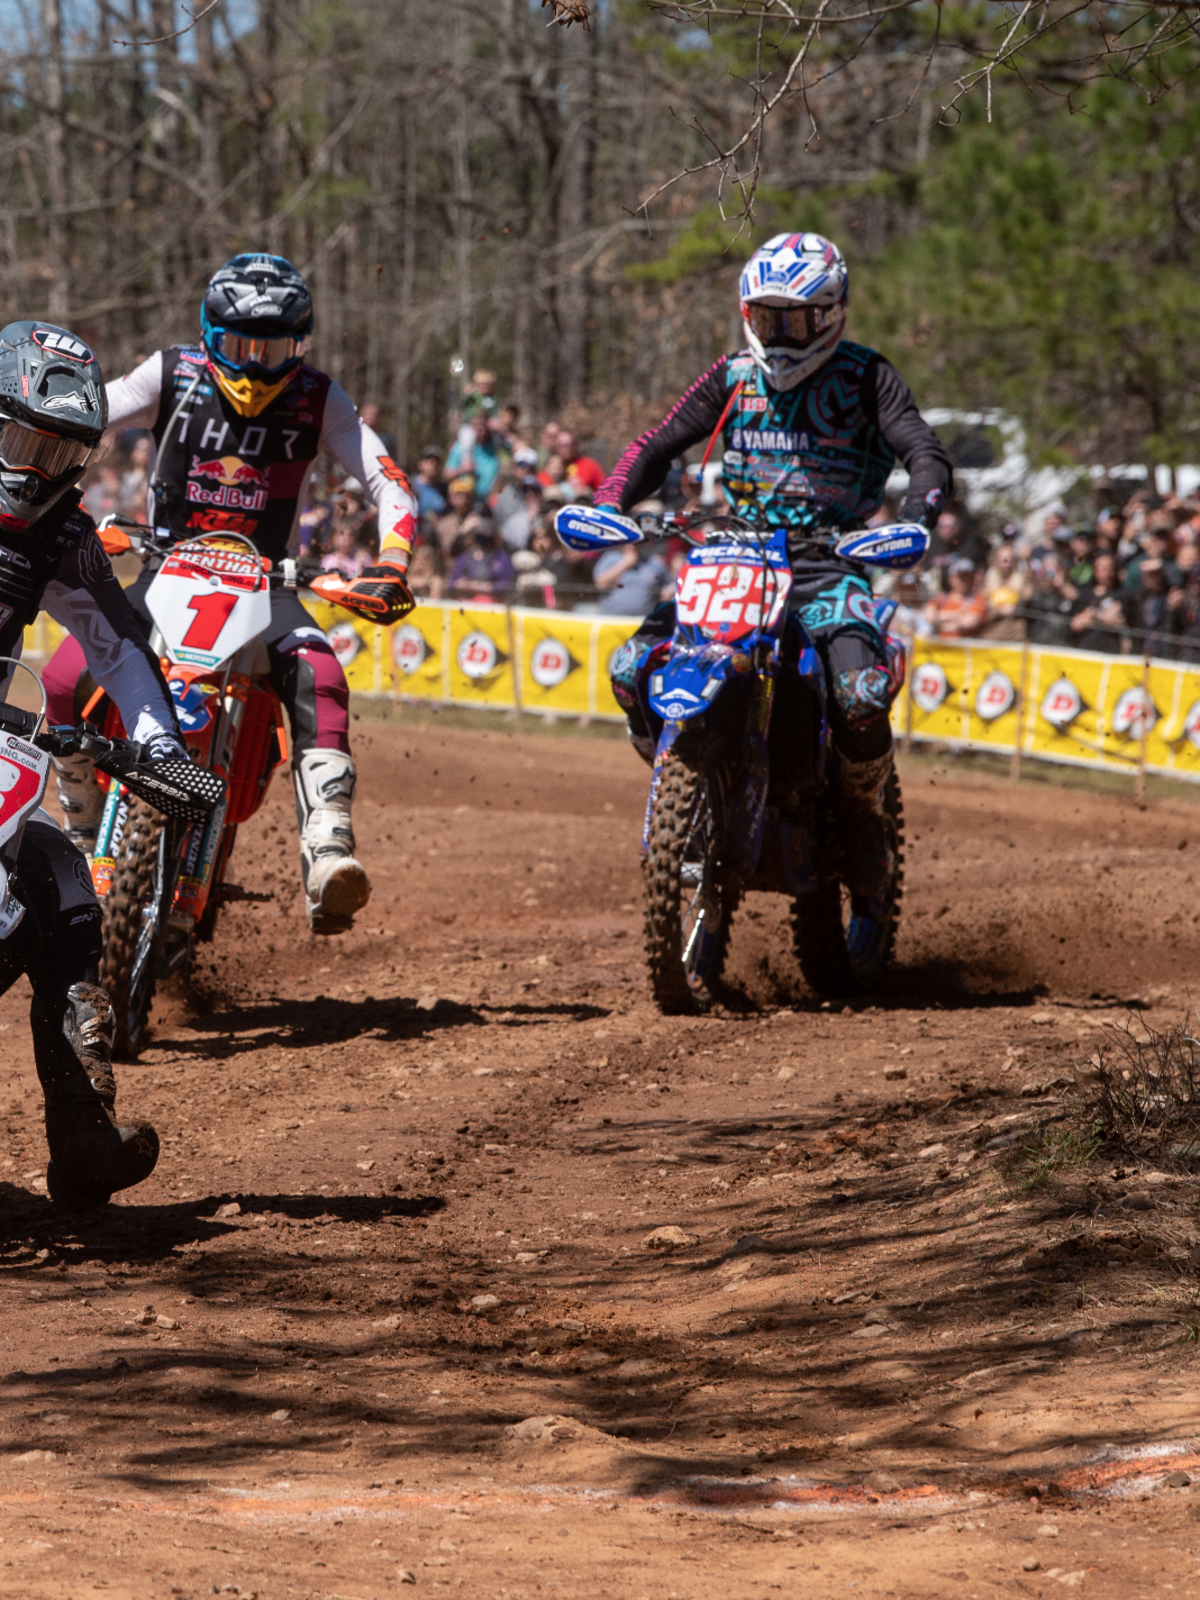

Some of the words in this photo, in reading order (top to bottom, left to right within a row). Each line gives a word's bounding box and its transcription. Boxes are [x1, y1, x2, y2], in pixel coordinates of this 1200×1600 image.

[742, 430, 810, 451] YAMAHA
[186, 480, 226, 507] Red
[226, 487, 268, 511] Bull
[185, 508, 259, 536] KTM
[678, 565, 792, 626] 523
[181, 591, 239, 651] 1
[110, 800, 129, 858] NLOP
